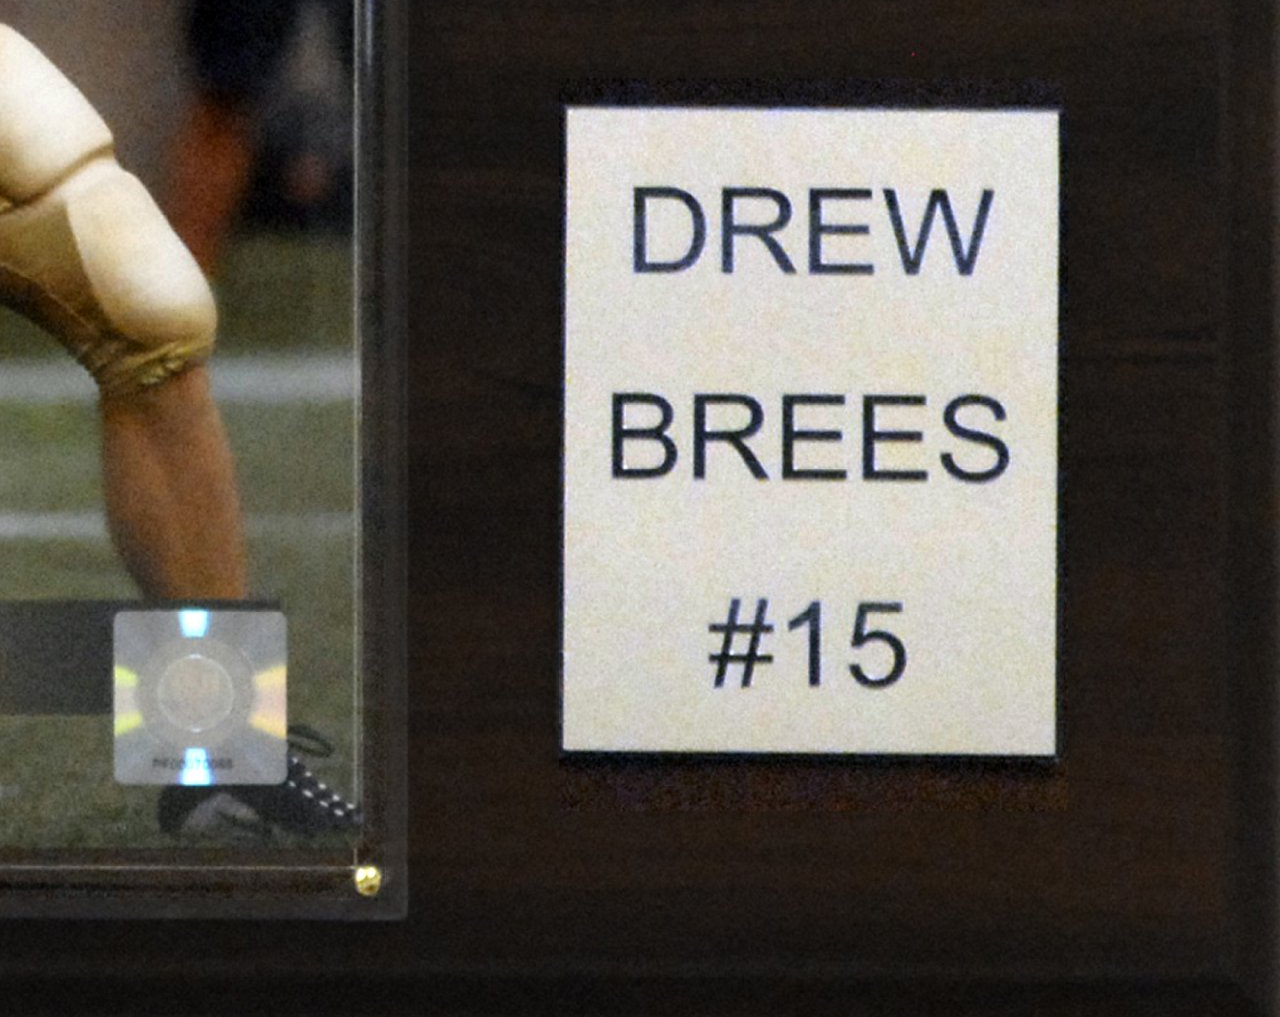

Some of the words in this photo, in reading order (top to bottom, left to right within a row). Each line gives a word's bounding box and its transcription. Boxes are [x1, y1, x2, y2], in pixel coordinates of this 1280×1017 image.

[632, 186, 995, 276] DREW
[611, 392, 1011, 484] BREES
[708, 597, 907, 688] #15
